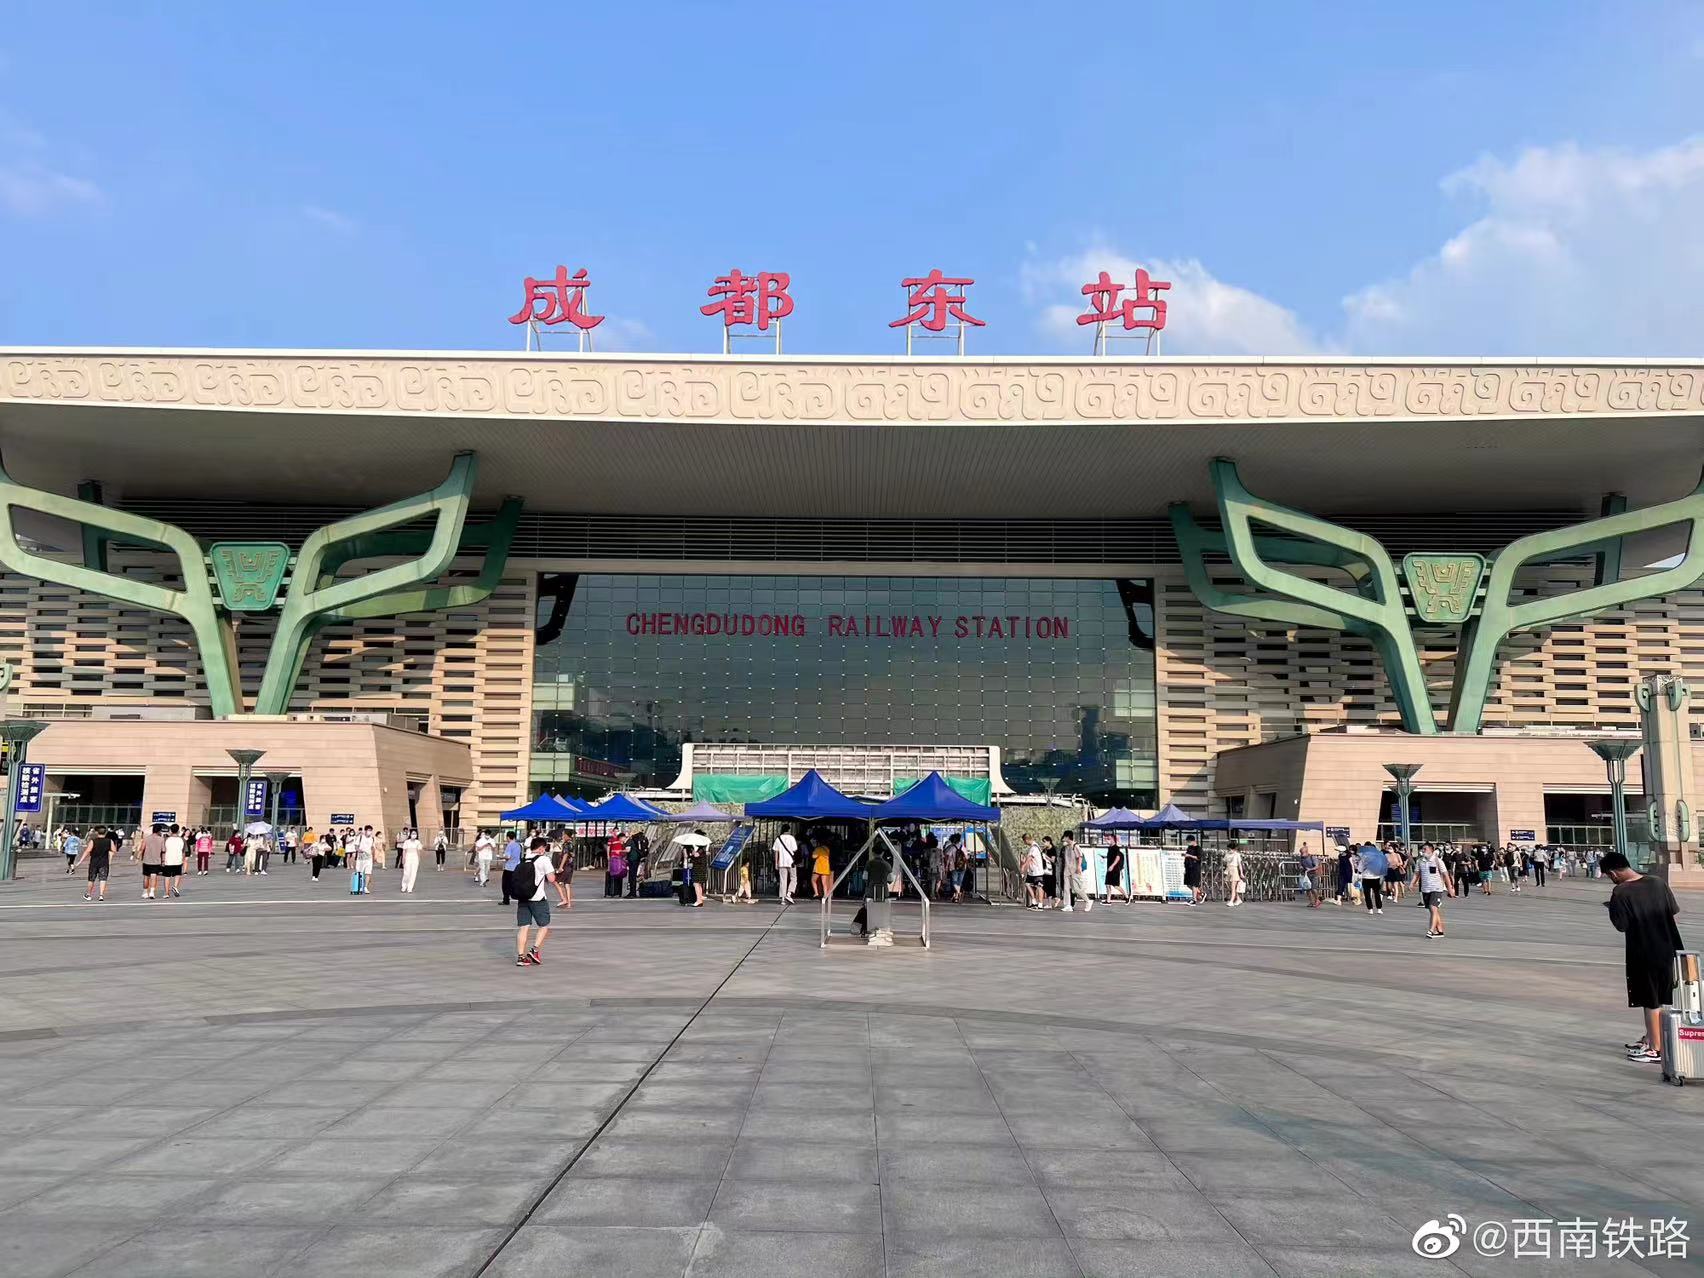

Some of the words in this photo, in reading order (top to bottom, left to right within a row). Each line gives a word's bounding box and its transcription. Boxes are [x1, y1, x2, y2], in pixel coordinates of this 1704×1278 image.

[508, 265, 1172, 331] 成都东站
[626, 612, 805, 637] CHENGDUDONG
[828, 614, 943, 638] RAILWAY
[954, 615, 1069, 639] STATION
